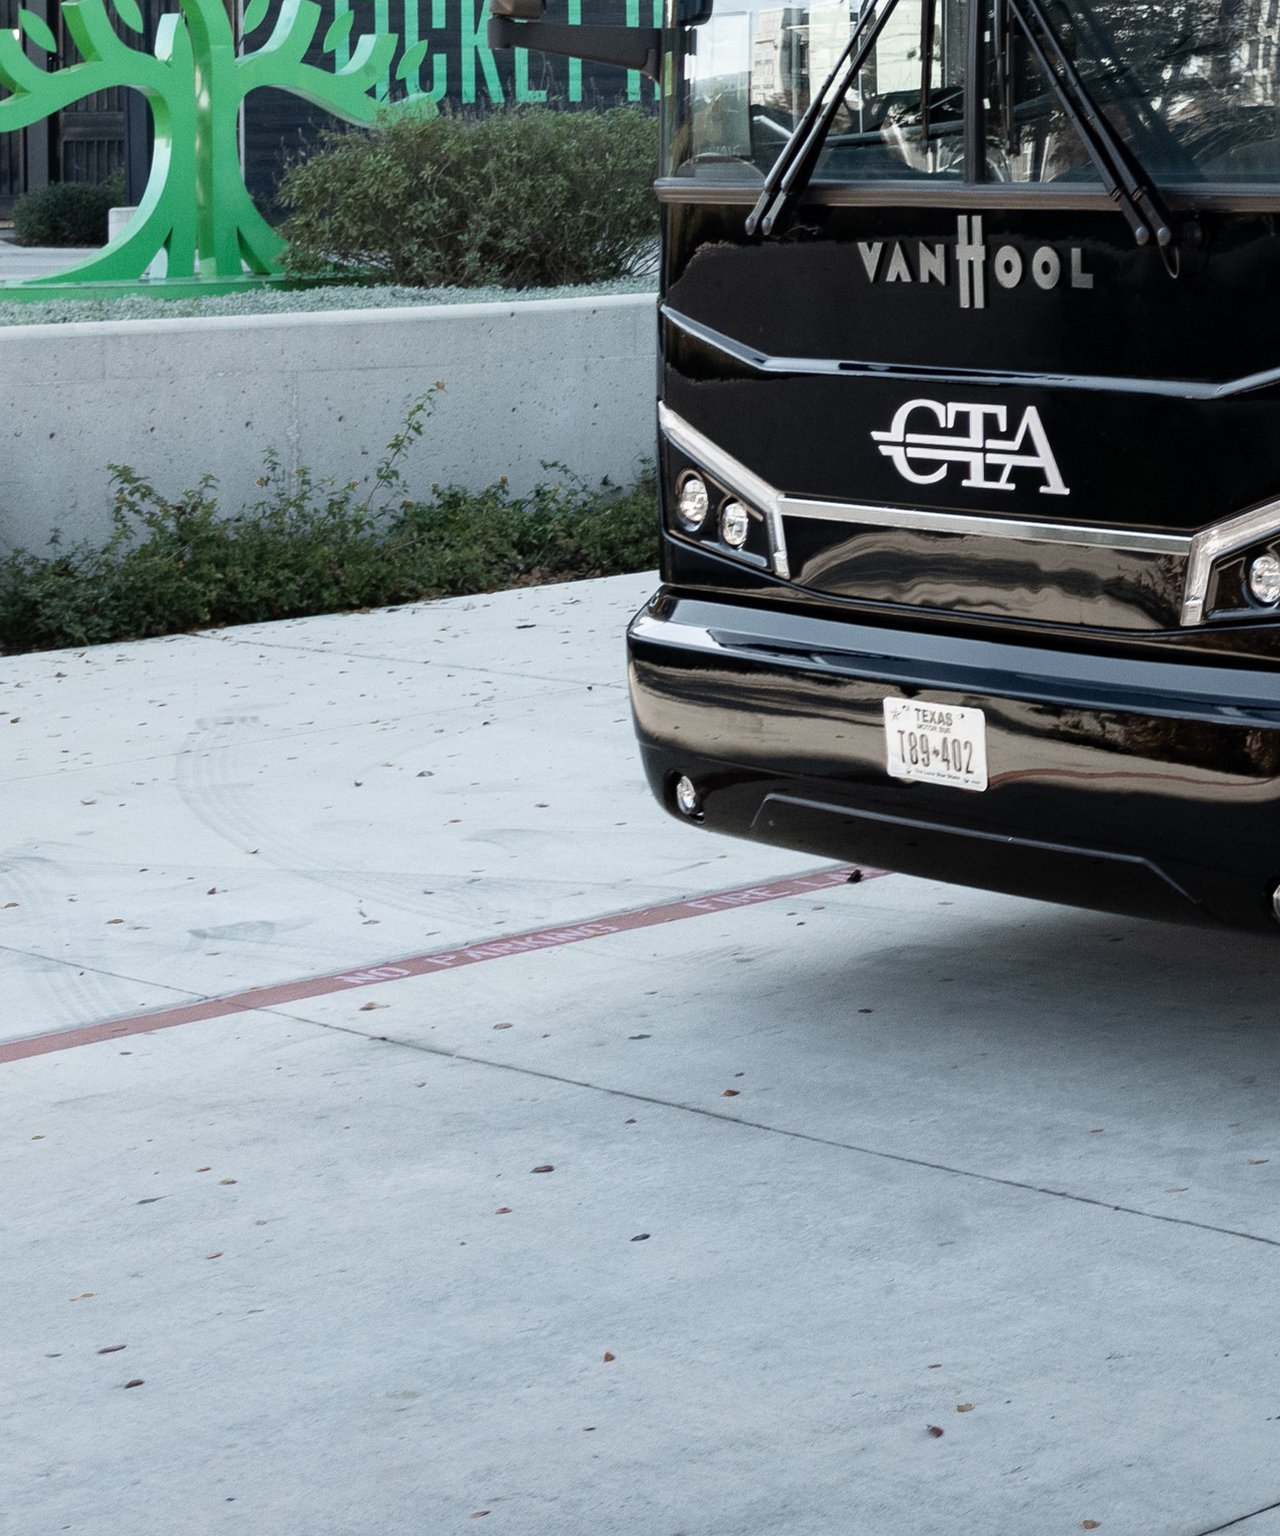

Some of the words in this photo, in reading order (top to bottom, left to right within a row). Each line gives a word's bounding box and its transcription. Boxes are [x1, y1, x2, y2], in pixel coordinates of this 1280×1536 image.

[870, 398, 1070, 495] CTA
[914, 708, 953, 726] TEXAS
[335, 966, 410, 985] NO
[686, 887, 791, 911] FIRE
